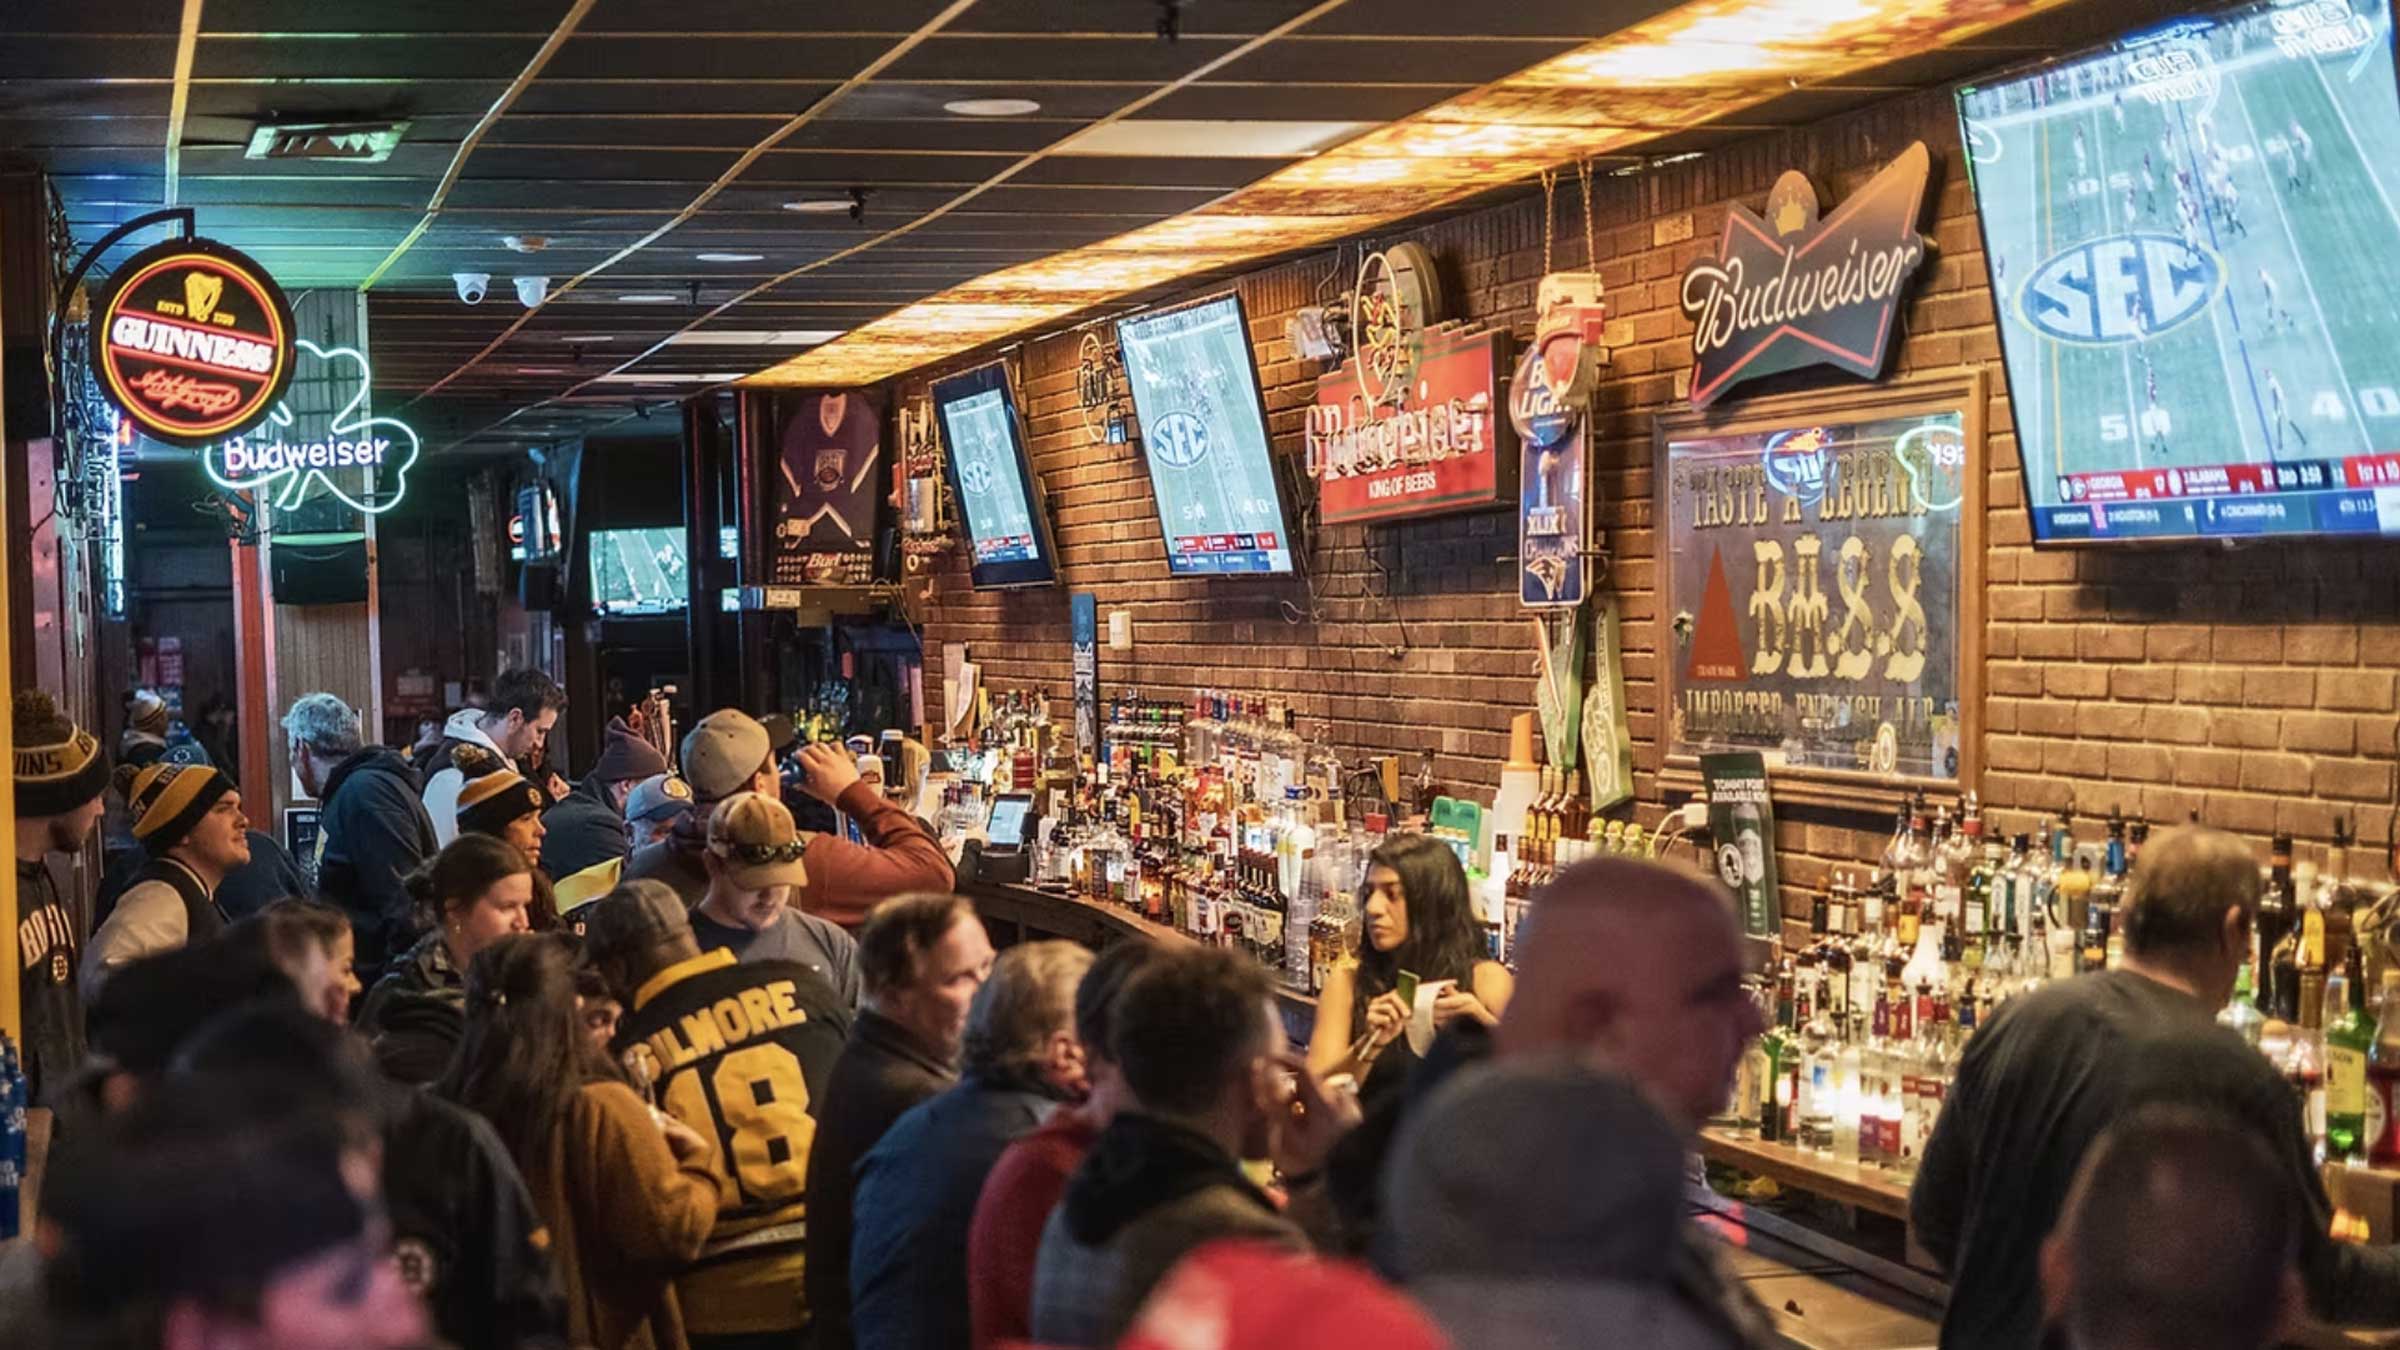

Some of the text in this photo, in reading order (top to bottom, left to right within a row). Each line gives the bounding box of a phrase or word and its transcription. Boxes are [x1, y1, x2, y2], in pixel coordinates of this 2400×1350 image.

[1683, 239, 1917, 354] Budweiser
[2033, 238, 2208, 337] SEC
[113, 316, 273, 374] GUINNESS
[224, 435, 390, 471] Budweiser
[1152, 414, 1208, 464] SEC
[1369, 472, 1437, 498] KING OF BEERS
[1749, 533, 1927, 683] BASS
[664, 1042, 817, 1208] 18
